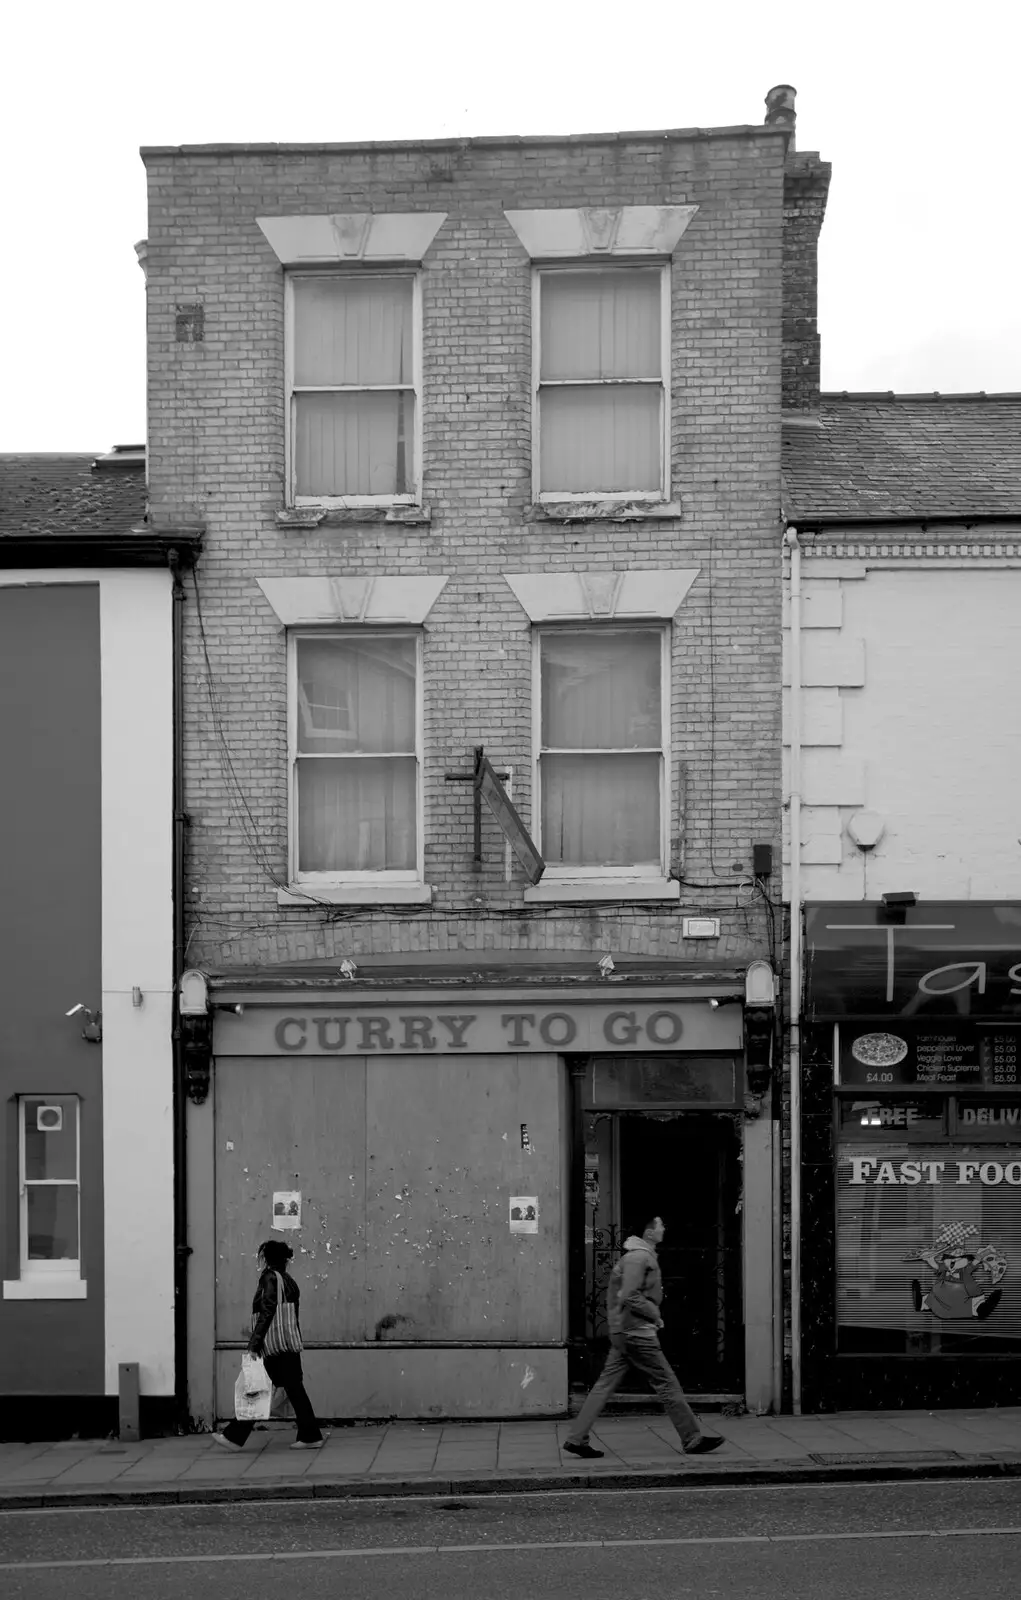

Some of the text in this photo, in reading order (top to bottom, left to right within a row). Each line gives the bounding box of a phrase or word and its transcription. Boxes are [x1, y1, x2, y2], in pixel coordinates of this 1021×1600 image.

[275, 1010, 684, 1051] CURRY TO GO
[994, 1045, 1017, 1054] £5.00
[994, 1055, 1017, 1063] £5.00
[994, 1065, 1017, 1073] £5.00
[866, 1072, 894, 1083] £4.00
[866, 1107, 919, 1126] FREE
[963, 1107, 1021, 1126] DELIV
[848, 1156, 946, 1186] FAST
